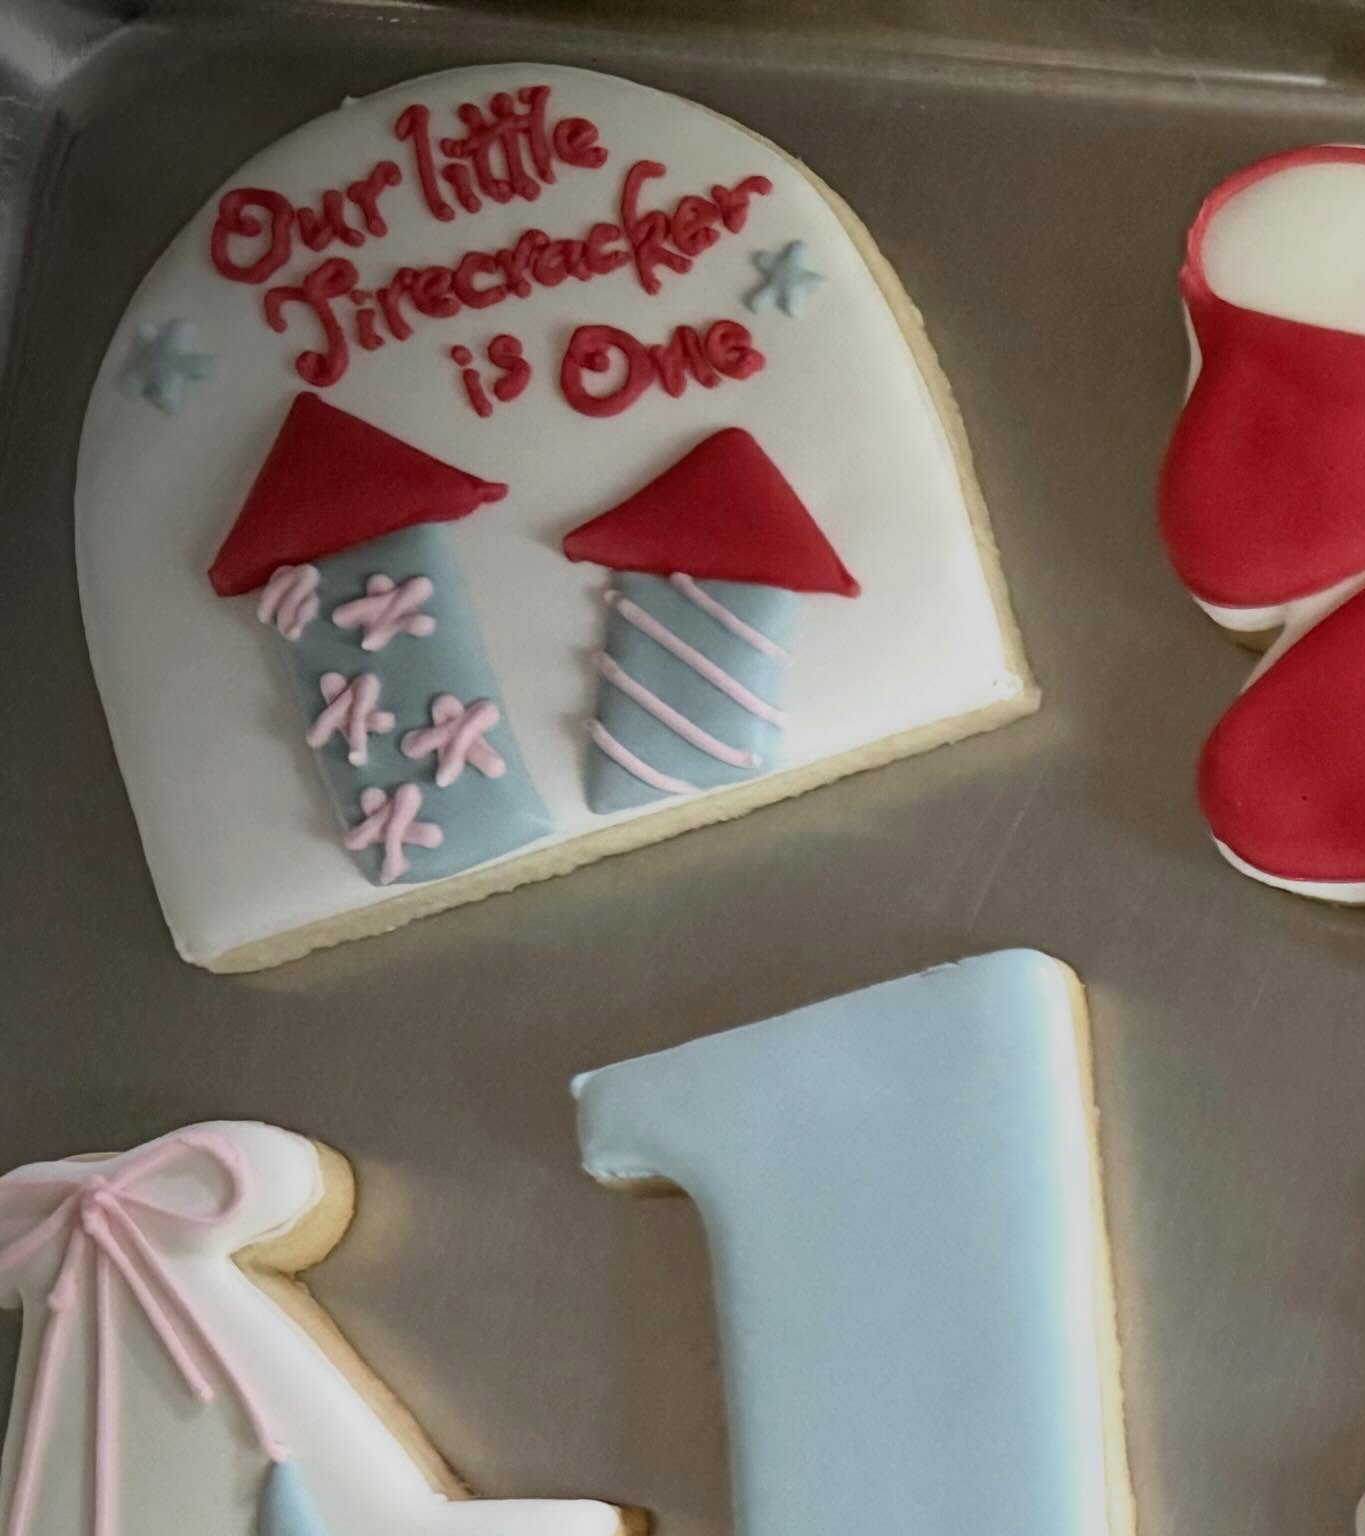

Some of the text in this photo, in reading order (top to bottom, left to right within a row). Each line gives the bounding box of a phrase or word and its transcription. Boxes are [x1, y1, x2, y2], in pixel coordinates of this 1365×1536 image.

[211, 84, 608, 285] Our little
[451, 320, 766, 419] is One
